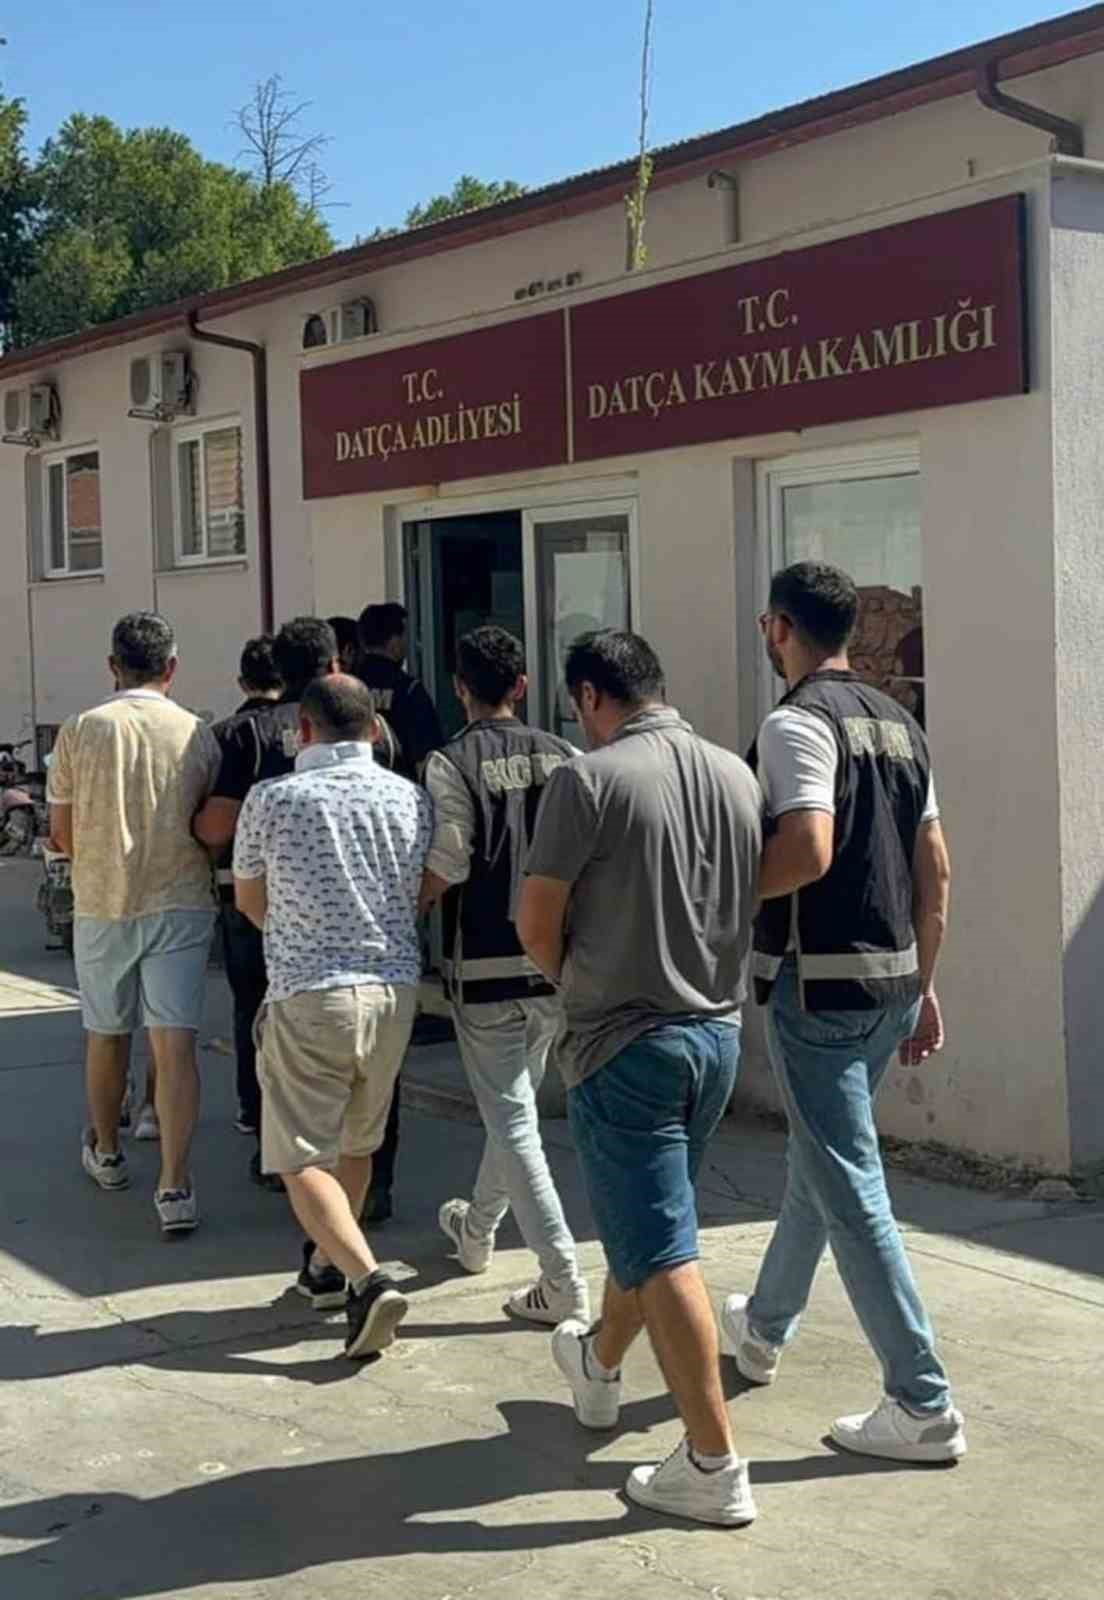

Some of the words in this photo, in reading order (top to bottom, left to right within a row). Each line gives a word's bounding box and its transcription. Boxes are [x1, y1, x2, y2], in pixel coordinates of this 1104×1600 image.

[737, 288, 799, 335] T.C.
[402, 368, 444, 404] T.C.
[587, 368, 687, 418] DATÇA
[693, 296, 998, 401] KAYMAKAMLIĞI
[335, 422, 408, 461] DATÇA
[409, 391, 522, 449] ADLİYESİ
